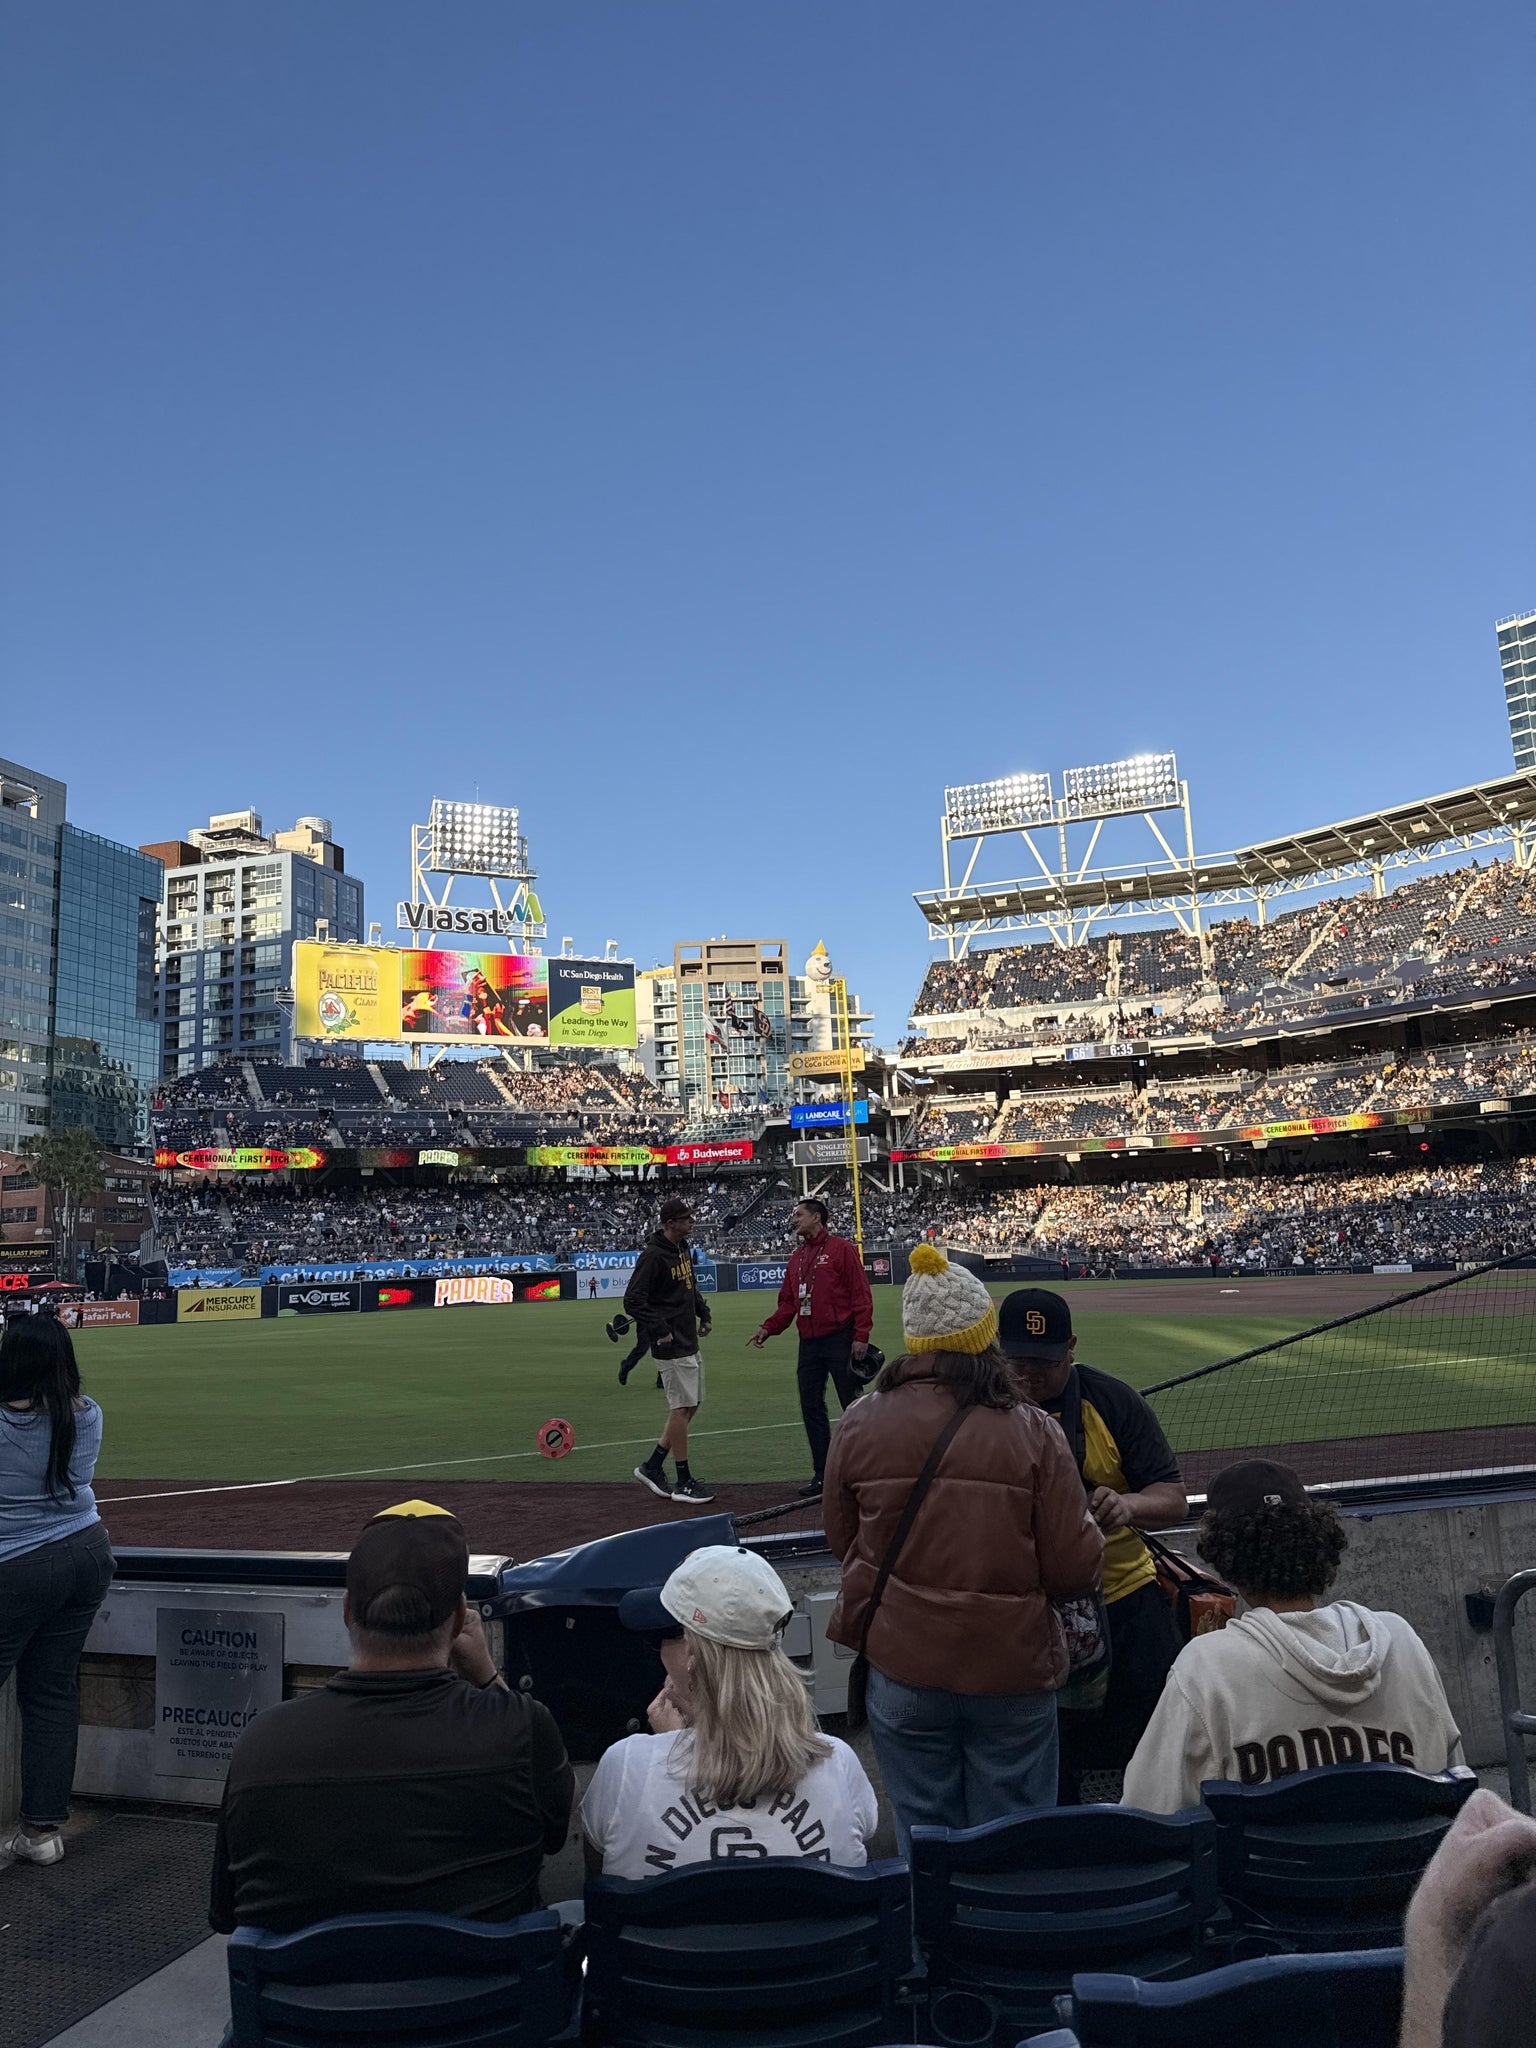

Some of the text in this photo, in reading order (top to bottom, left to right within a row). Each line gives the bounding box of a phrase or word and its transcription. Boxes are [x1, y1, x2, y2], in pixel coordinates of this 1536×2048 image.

[404, 902, 504, 933] Viasat
[559, 969, 624, 981] UC San Diego Health
[582, 987, 600, 995] BEST
[561, 1016, 629, 1028] Leading the Way
[561, 1027, 608, 1038] in San Diego
[1110, 1043, 1134, 1056] 6:35
[823, 1057, 861, 1067] ICHIBAYA
[805, 1109, 840, 1120] LANDCARE
[1266, 1119, 1347, 1134] CEREMONIAL FIRST PITCH
[693, 1147, 743, 1158] Budweiser
[816, 1143, 852, 1151] SINGLETO
[931, 1147, 1006, 1157] CEREMONIAL FIRST PITCH
[182, 1153, 290, 1164] CEREMONIAL FIRST PITCH
[418, 1149, 459, 1166] PADRES
[567, 1151, 650, 1161] CEREMONIAL FIRST PITCH
[816, 1150, 853, 1158] SCHREIBE
[0, 1249, 29, 1257] BALLAST
[29, 1248, 49, 1256] POINT
[759, 1266, 787, 1283] petc
[0, 1274, 30, 1291] CES
[579, 1278, 600, 1289] ble
[612, 1277, 630, 1288] blu
[289, 1290, 350, 1306] EVOTEK
[434, 1277, 514, 1307] PADRES
[206, 1295, 256, 1305] MERCURY
[206, 1303, 256, 1312] INSURANCE
[82, 1310, 132, 1322] Safari Park
[1026, 1310, 1046, 1335] SD
[181, 1629, 257, 1649] CAUTION
[179, 1648, 259, 1660] BE AWARE OF OBJECTS
[170, 1658, 201, 1667] LEAVING
[202, 1660, 216, 1668] THE
[217, 1661, 237, 1670] FIELD
[250, 1663, 268, 1672] PLAY
[162, 1706, 258, 1728] PRECAUCI
[177, 1727, 241, 1738] ESTE AL PENDIEN
[169, 1737, 234, 1749] OBJETOS QUE ABA
[177, 1749, 233, 1761] EL TERRENO DE
[767, 1789, 831, 1863] PAD
